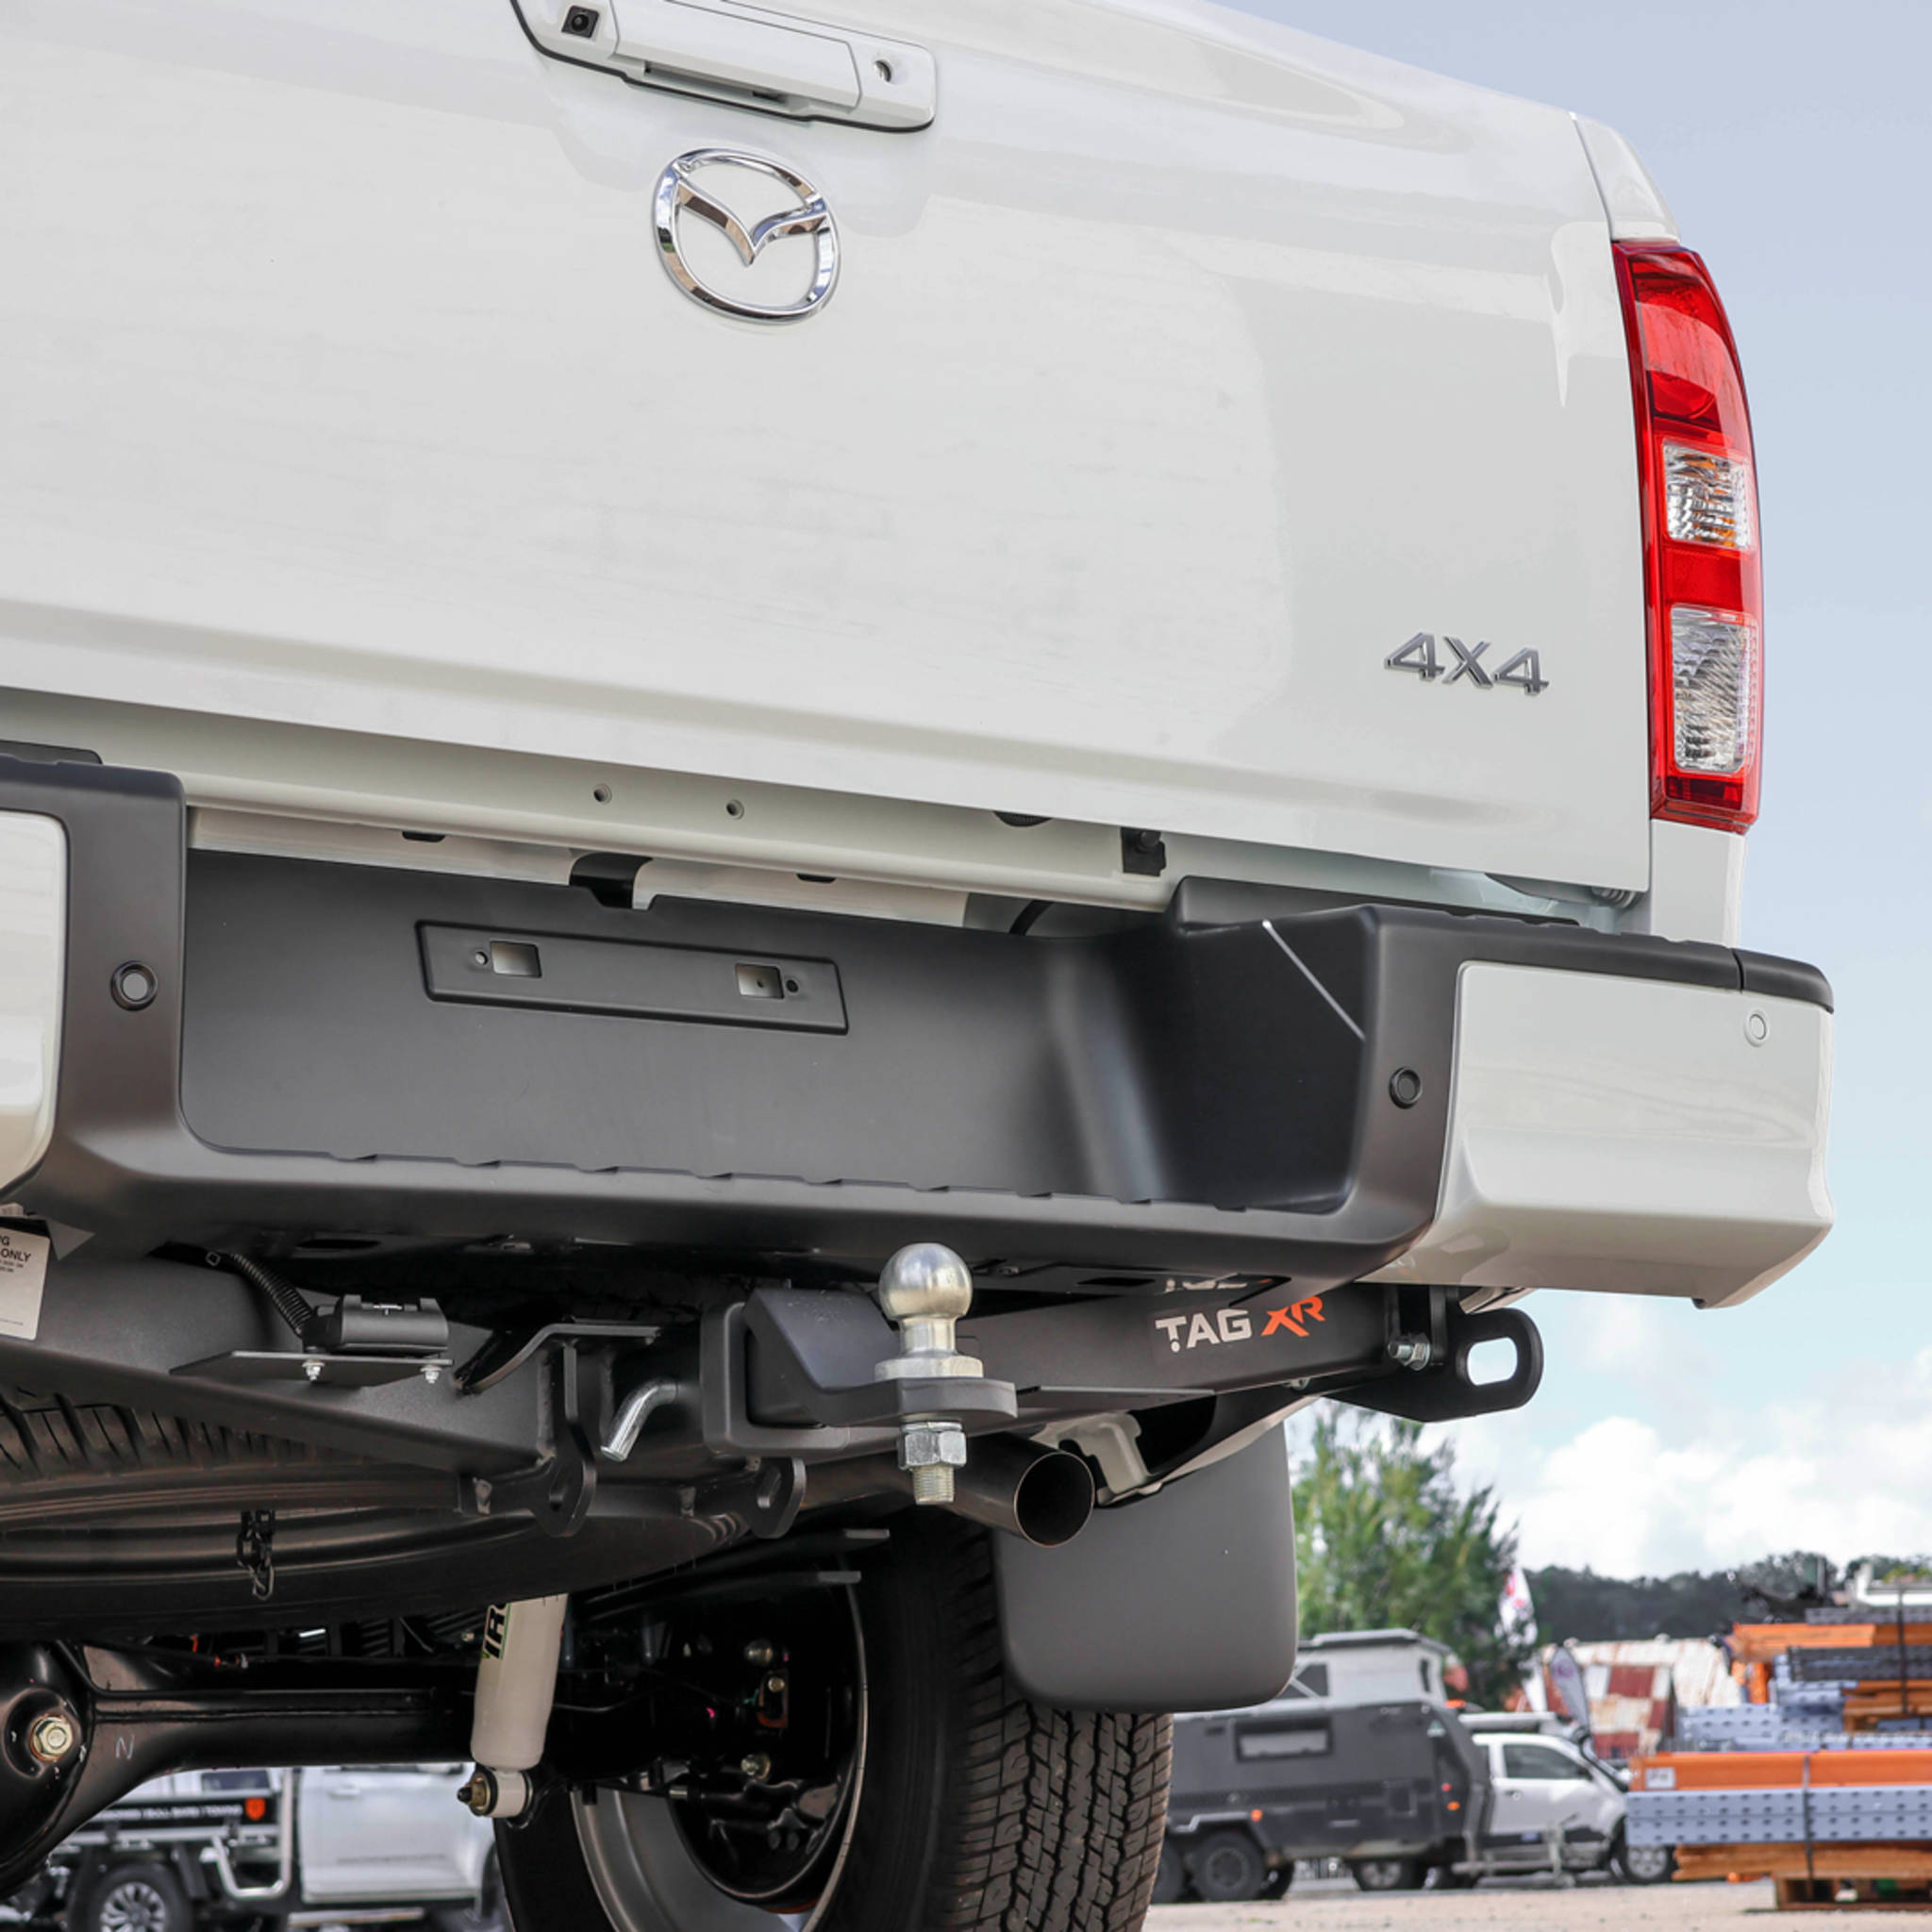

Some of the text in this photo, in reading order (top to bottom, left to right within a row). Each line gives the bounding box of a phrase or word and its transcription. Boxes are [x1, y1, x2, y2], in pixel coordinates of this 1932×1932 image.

[1384, 632, 1549, 696] 4X4
[0, 1247, 32, 1262] ONLY
[1155, 1295, 1326, 1353] TAG XR
[484, 1603, 508, 1659] IR
